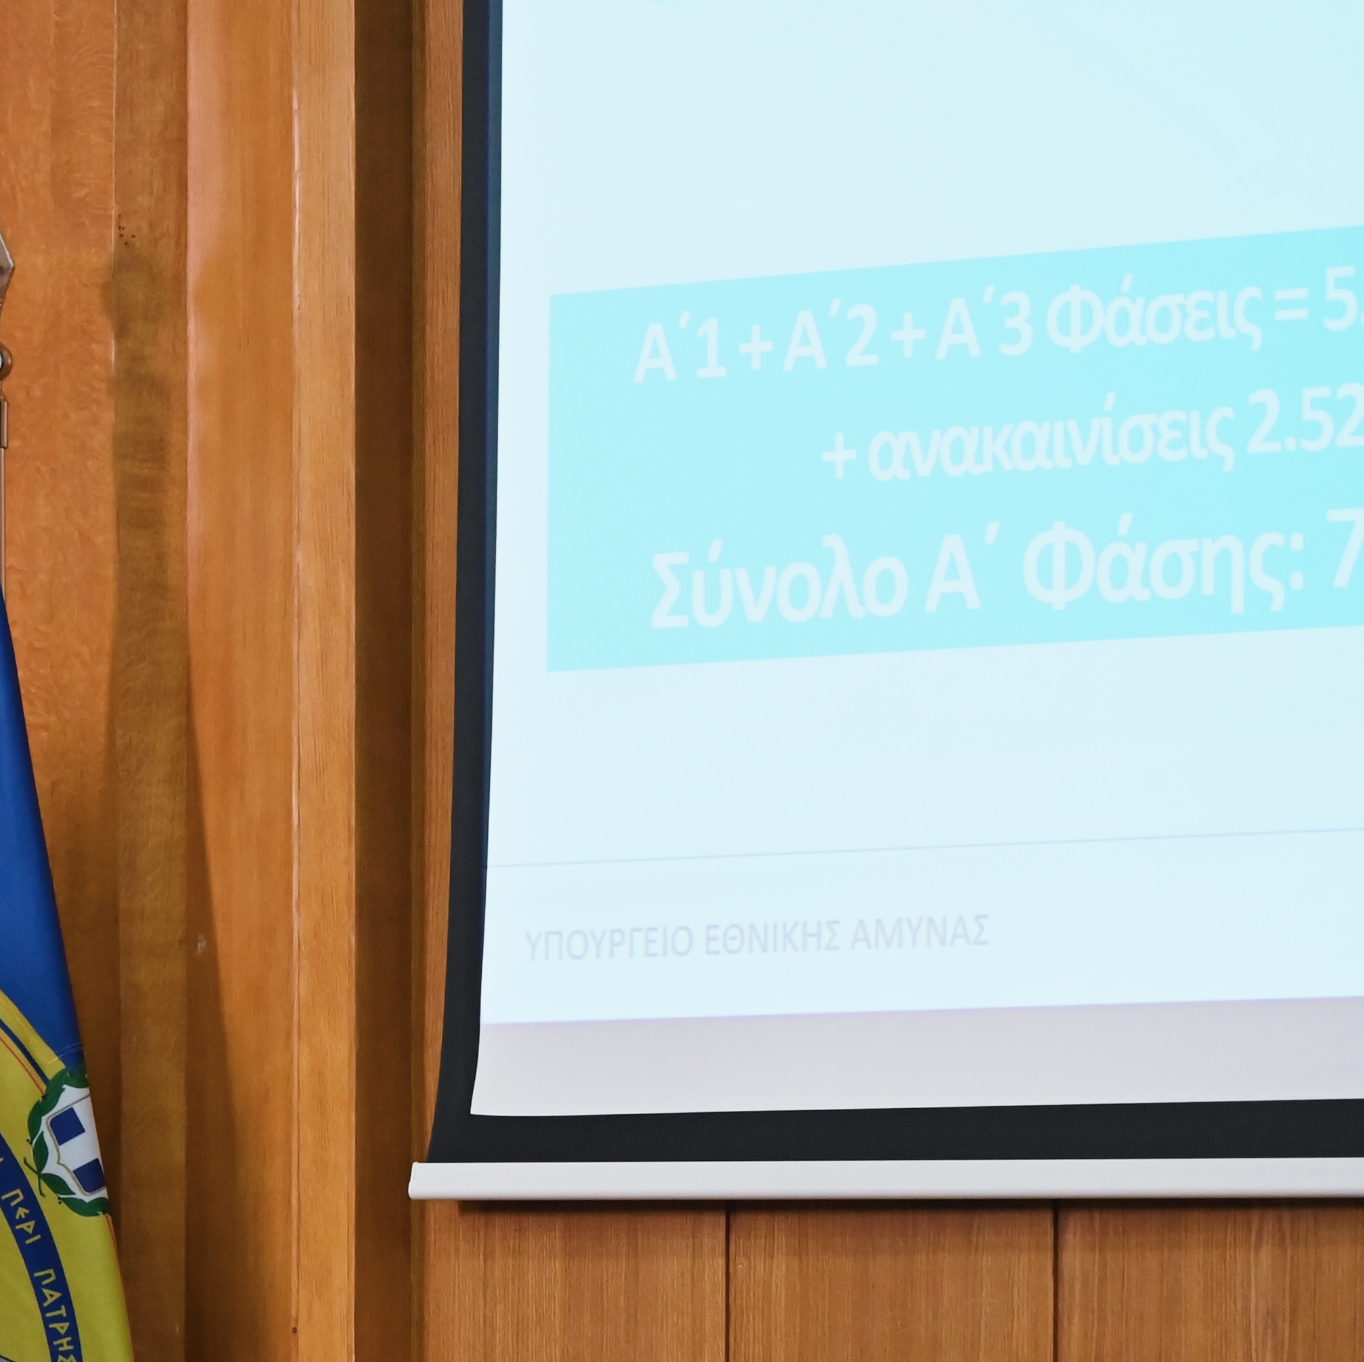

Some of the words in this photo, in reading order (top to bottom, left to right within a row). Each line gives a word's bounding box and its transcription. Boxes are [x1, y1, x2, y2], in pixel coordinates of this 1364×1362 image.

[1045, 272, 1264, 353] Φάσεις
[869, 391, 1236, 482] ανακαινίσεις
[650, 533, 909, 630] Σύνολο
[1022, 512, 1304, 615] Φάσης:
[525, 925, 694, 962] ΥΠΟΥΡΓΕΙΟ
[704, 919, 842, 956] ΕΘΝΙΚΗΣ
[850, 914, 990, 951] ΑΜΥΝΑΣ
[0, 1188, 42, 1245] ΠΕΡΙ
